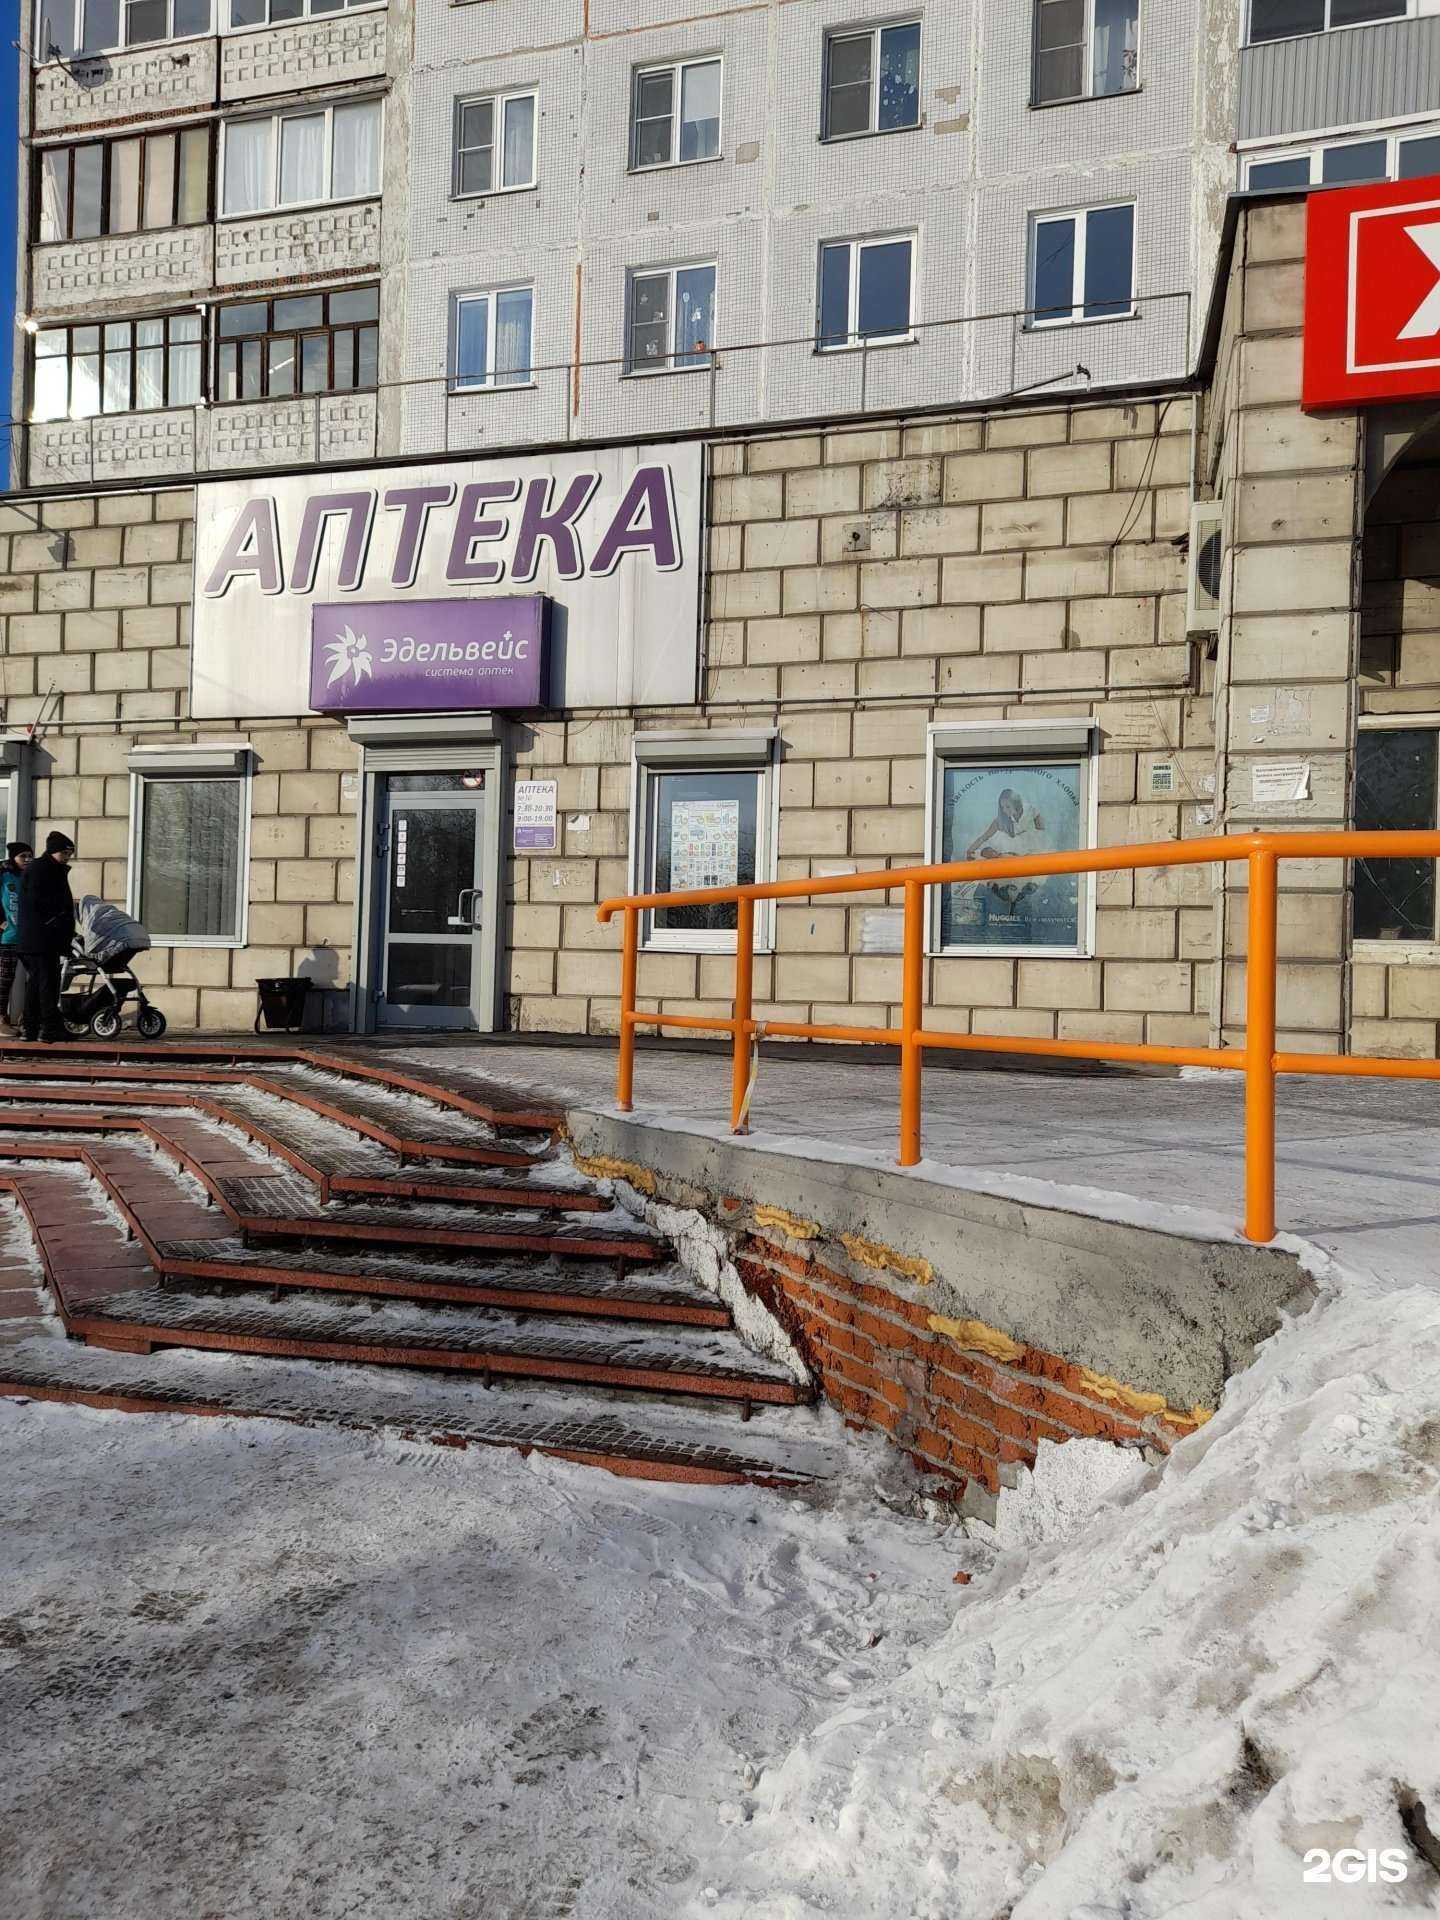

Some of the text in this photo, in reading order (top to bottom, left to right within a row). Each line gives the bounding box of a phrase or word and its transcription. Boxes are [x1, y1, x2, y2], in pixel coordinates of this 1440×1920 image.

[203, 464, 682, 598] АПТЕКА
[380, 631, 529, 662] Эдельвейс
[425, 666, 514, 677] система аптек
[518, 784, 554, 794] АПТЕКА
